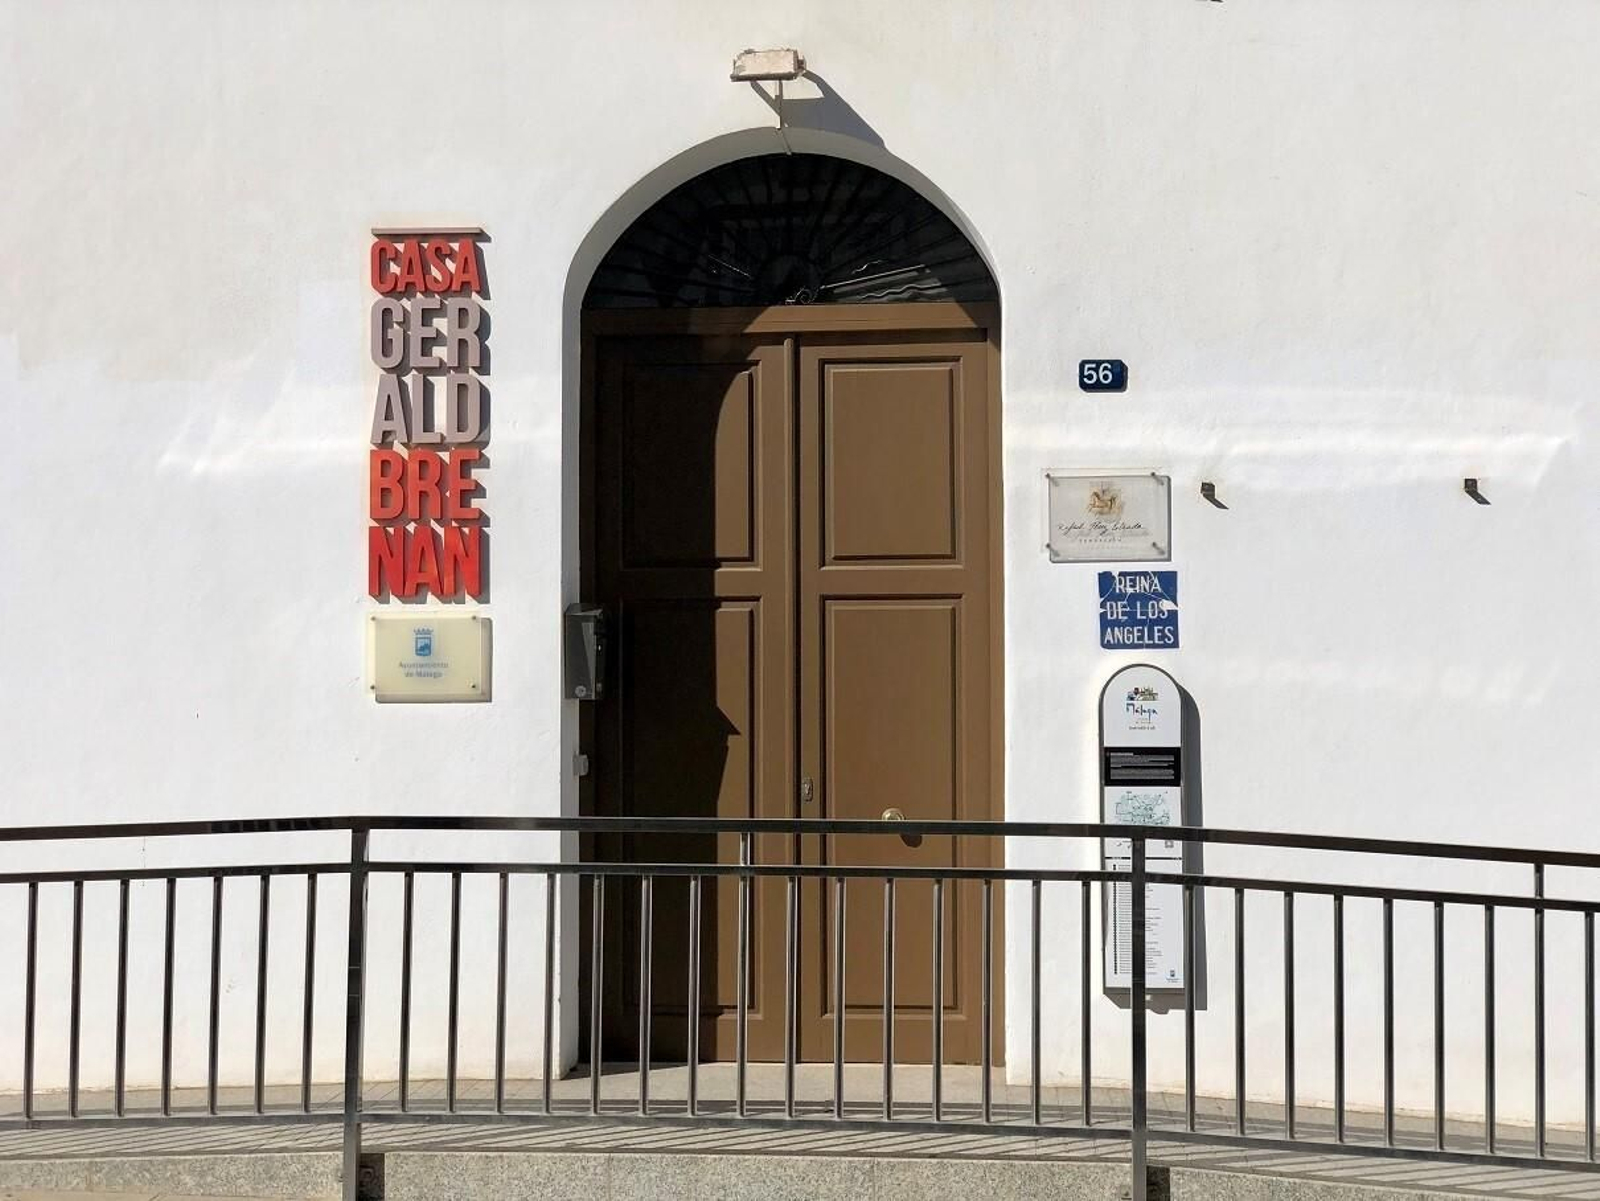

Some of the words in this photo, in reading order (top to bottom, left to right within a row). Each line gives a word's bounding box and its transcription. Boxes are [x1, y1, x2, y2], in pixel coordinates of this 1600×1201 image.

[370, 238, 481, 293] CASA
[370, 297, 481, 369] GER
[1083, 363, 1113, 384] 56
[370, 373, 481, 444] ALD
[369, 449, 481, 520] BRE
[368, 525, 481, 598] NAN
[1115, 576, 1162, 593] REINA
[1106, 601, 1129, 620] DE
[1136, 600, 1169, 620] LOS
[1104, 626, 1175, 645] ANGELES
[404, 669, 414, 677] de
